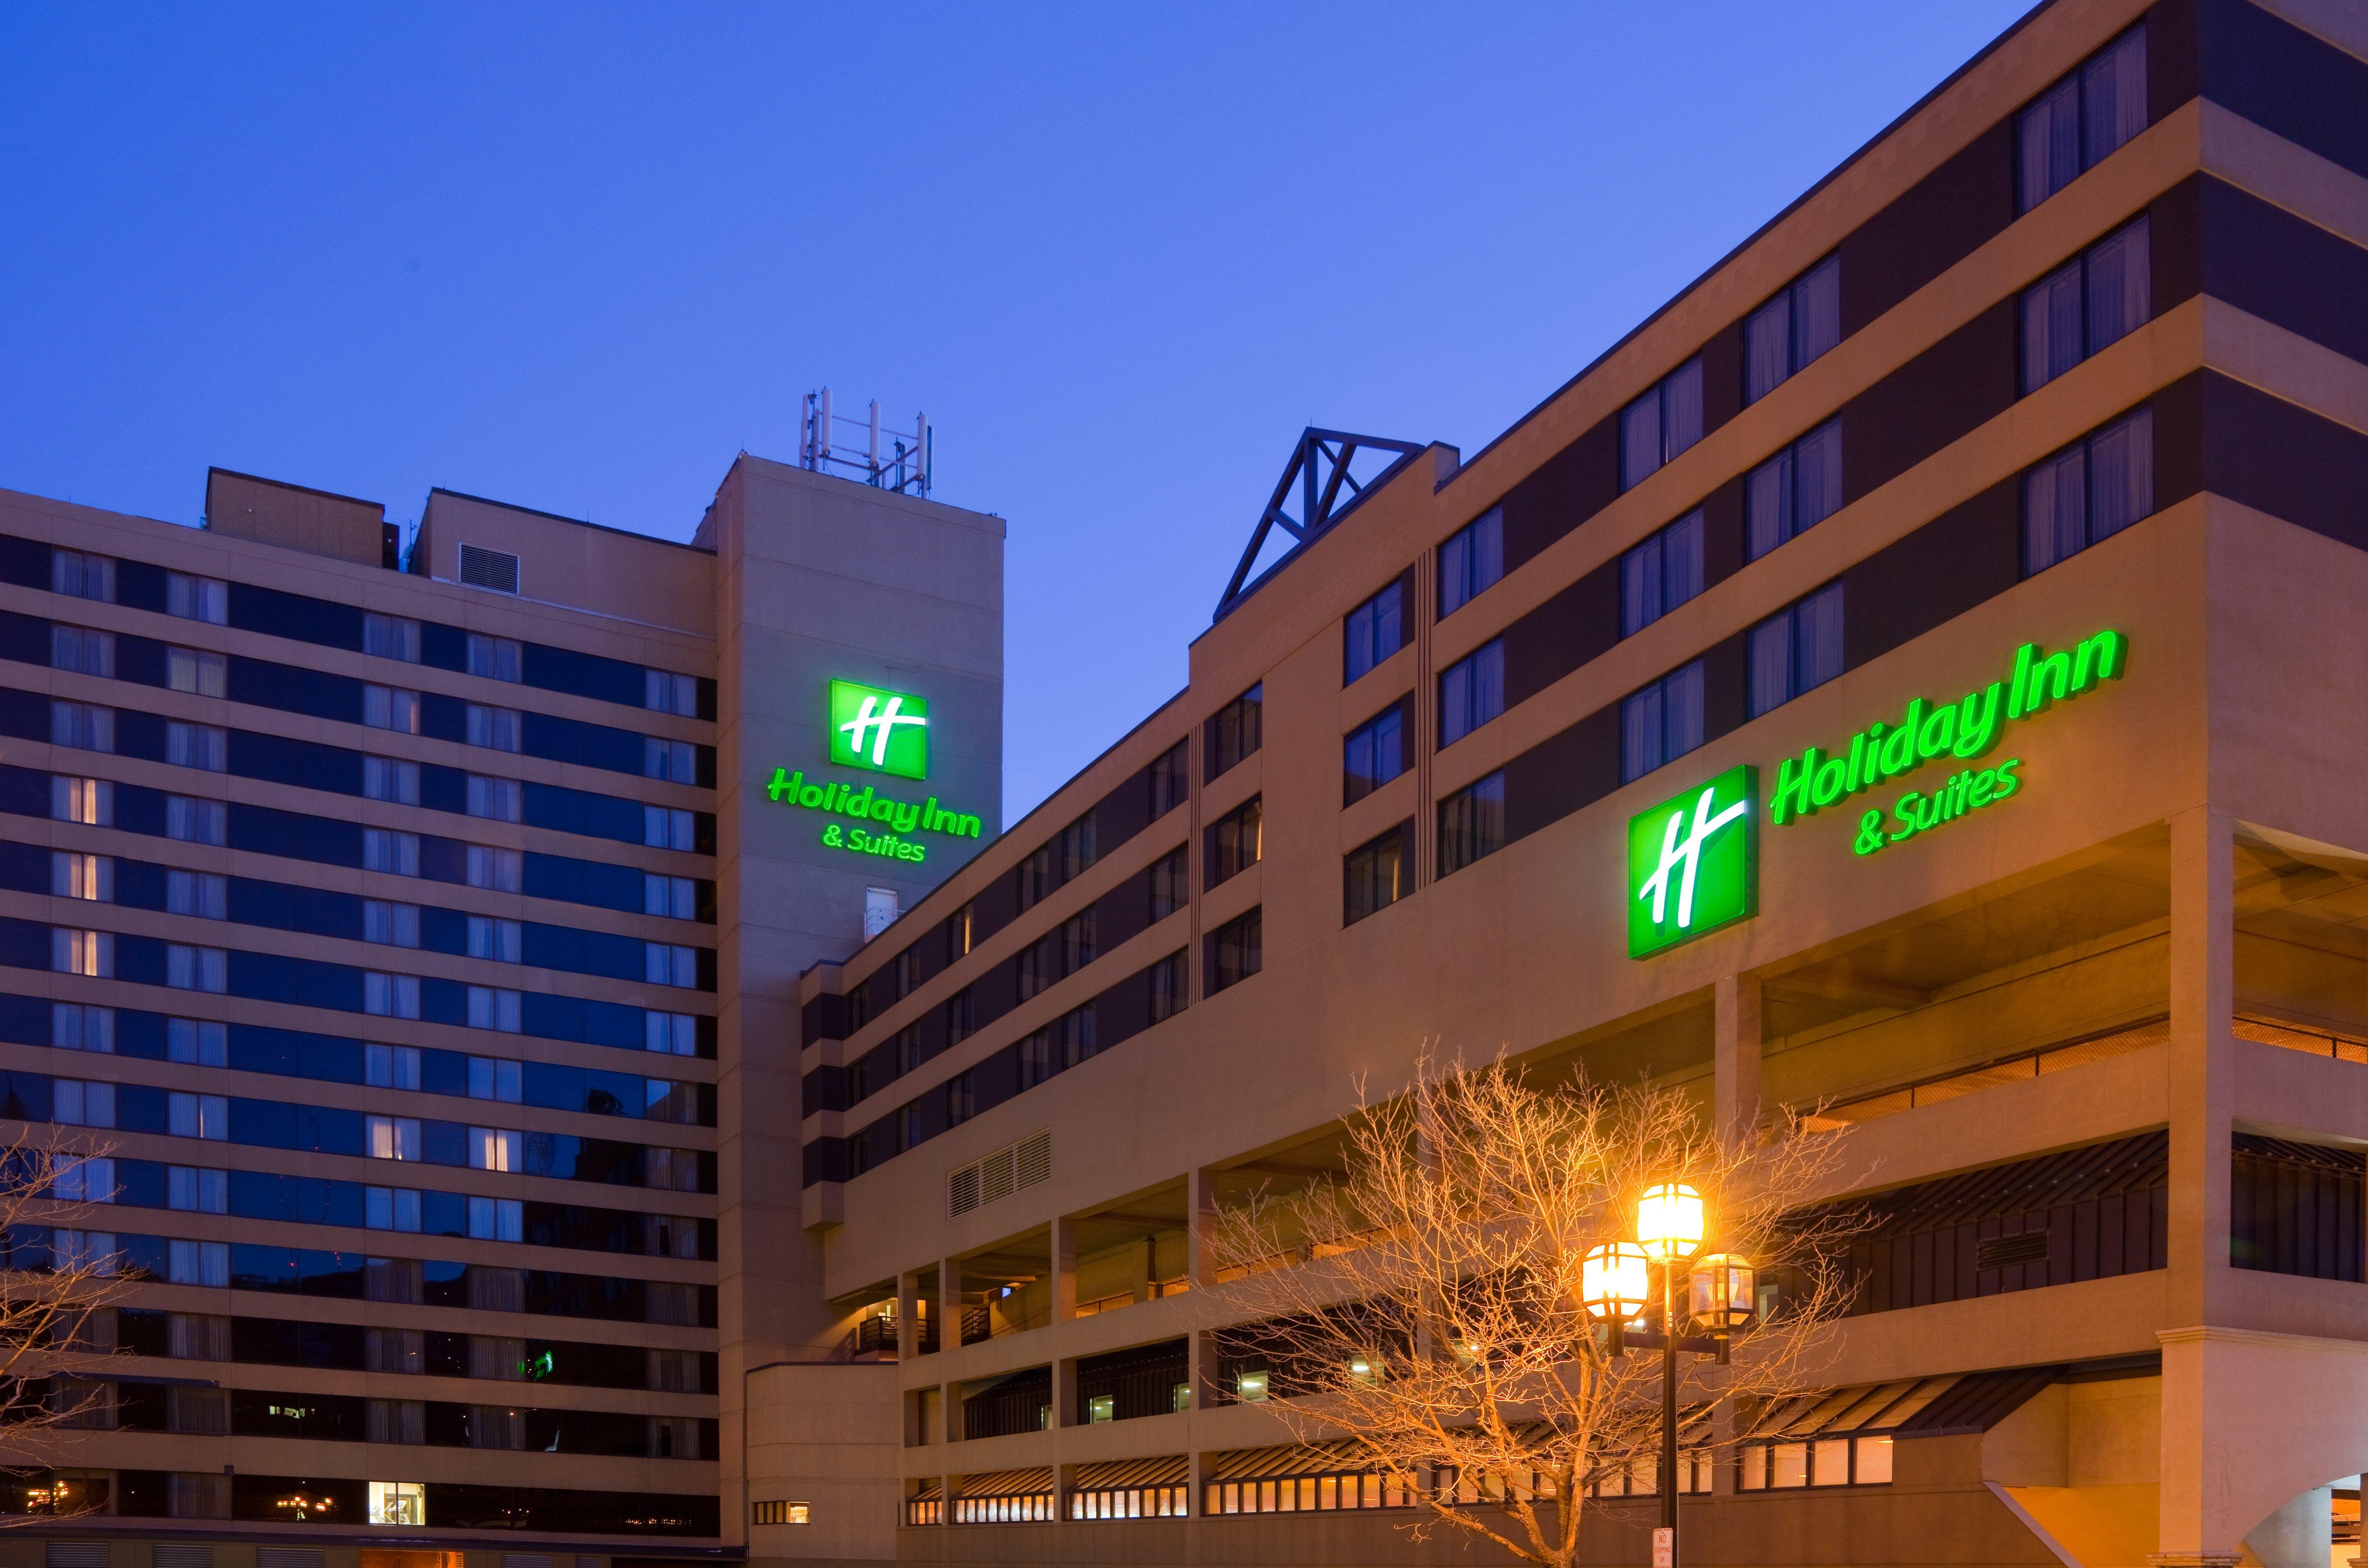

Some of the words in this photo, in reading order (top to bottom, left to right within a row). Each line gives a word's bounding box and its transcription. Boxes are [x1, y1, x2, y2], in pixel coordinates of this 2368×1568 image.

[1770, 681, 2002, 824] Holiday
[2007, 630, 2123, 720] Inn
[767, 768, 920, 833] Holiday
[922, 797, 981, 839] Inn
[1854, 809, 1885, 855] &
[1890, 759, 2021, 842] Suites
[823, 825, 842, 847] &
[848, 829, 926, 862] Suites
[1659, 1534, 1666, 1543] NO
